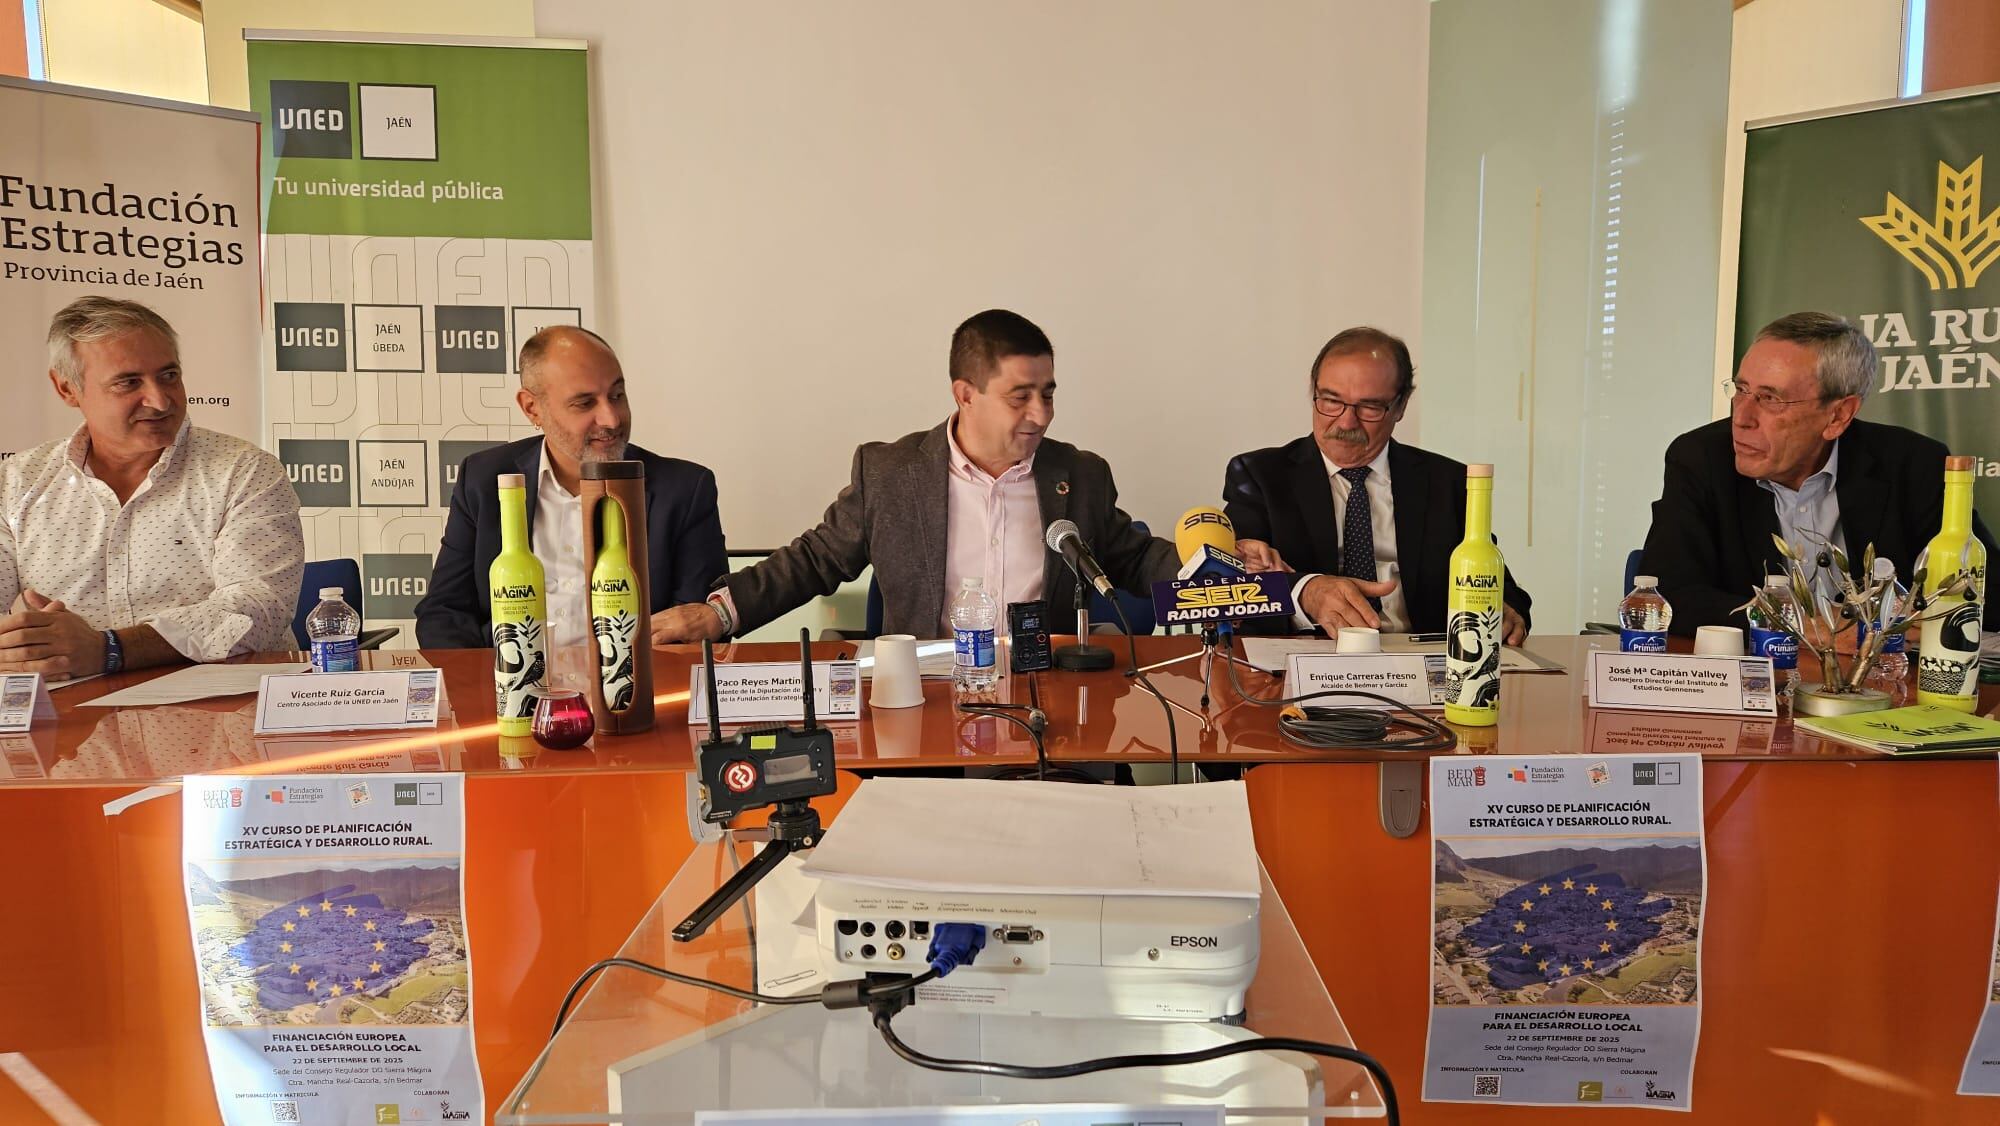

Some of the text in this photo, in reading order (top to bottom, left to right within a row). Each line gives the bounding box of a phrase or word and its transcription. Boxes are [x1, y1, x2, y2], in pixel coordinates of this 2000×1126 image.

[279, 108, 344, 131] UNED
[386, 116, 412, 130] JAÉN
[274, 177, 504, 203] Tu universidad pública
[0, 174, 239, 228] Fundación
[1, 216, 244, 269] Estrategias
[4, 262, 204, 290] Provincia de Jaén
[375, 322, 402, 336] JAÉN
[281, 327, 339, 348] UNED
[441, 329, 499, 350] UNED
[372, 341, 406, 354] ÚBEDA
[186, 396, 230, 407] en.org
[379, 458, 405, 472] JAÉN
[286, 463, 343, 483] UNED
[371, 477, 415, 490] ANDÚJAR
[1184, 512, 1233, 533] SER
[1208, 547, 1247, 571] SER
[370, 577, 427, 596] UNED
[1172, 574, 1263, 589] CADENA
[1176, 583, 1269, 610] SER
[1167, 602, 1282, 621] RADIO JODAR
[1310, 672, 1417, 682] Enrique Carreras Fresno
[1608, 666, 1728, 681] José Mª Capitán Vallvey
[717, 676, 801, 688] Paco Reyes Martín
[1608, 676, 1644, 685] Consejero
[1687, 679, 1718, 687] Instituto
[291, 687, 385, 699] Vicente Ruiz García
[757, 686, 791, 695] Diputación
[1664, 686, 1704, 694] Giennenses
[302, 699, 332, 707] Asociado
[737, 694, 770, 702] Fundación
[1448, 769, 1473, 779] BED
[1635, 770, 1654, 778] UNED
[1447, 778, 1473, 788] MAR
[203, 790, 229, 800] BED
[396, 790, 416, 798] UNED
[203, 799, 229, 809] MAR
[1487, 800, 1651, 814] XV CURSO DE PLANIFICACIÓN
[1469, 814, 1672, 828] ESTRATÉGICA Y DESARROLLO RURAL.
[242, 820, 413, 836] XV CURSO DE PLANIFICACIÓN
[225, 836, 433, 850] ESTRATÉGICA Y DESARROLLO RURAL.
[1170, 935, 1218, 948] EPSON
[1494, 1010, 1631, 1022] FINANCIACIÓN EUROPEA
[1482, 1022, 1643, 1032] PARA EL DESARROLLO LOCAL
[273, 1031, 406, 1042] FINANCIACIÓN EUROPEA
[264, 1043, 422, 1053] PARA EL DESARROLLO LOCAL
[1546, 1045, 1581, 1053] Regulador
[335, 1067, 369, 1075] Regulador
